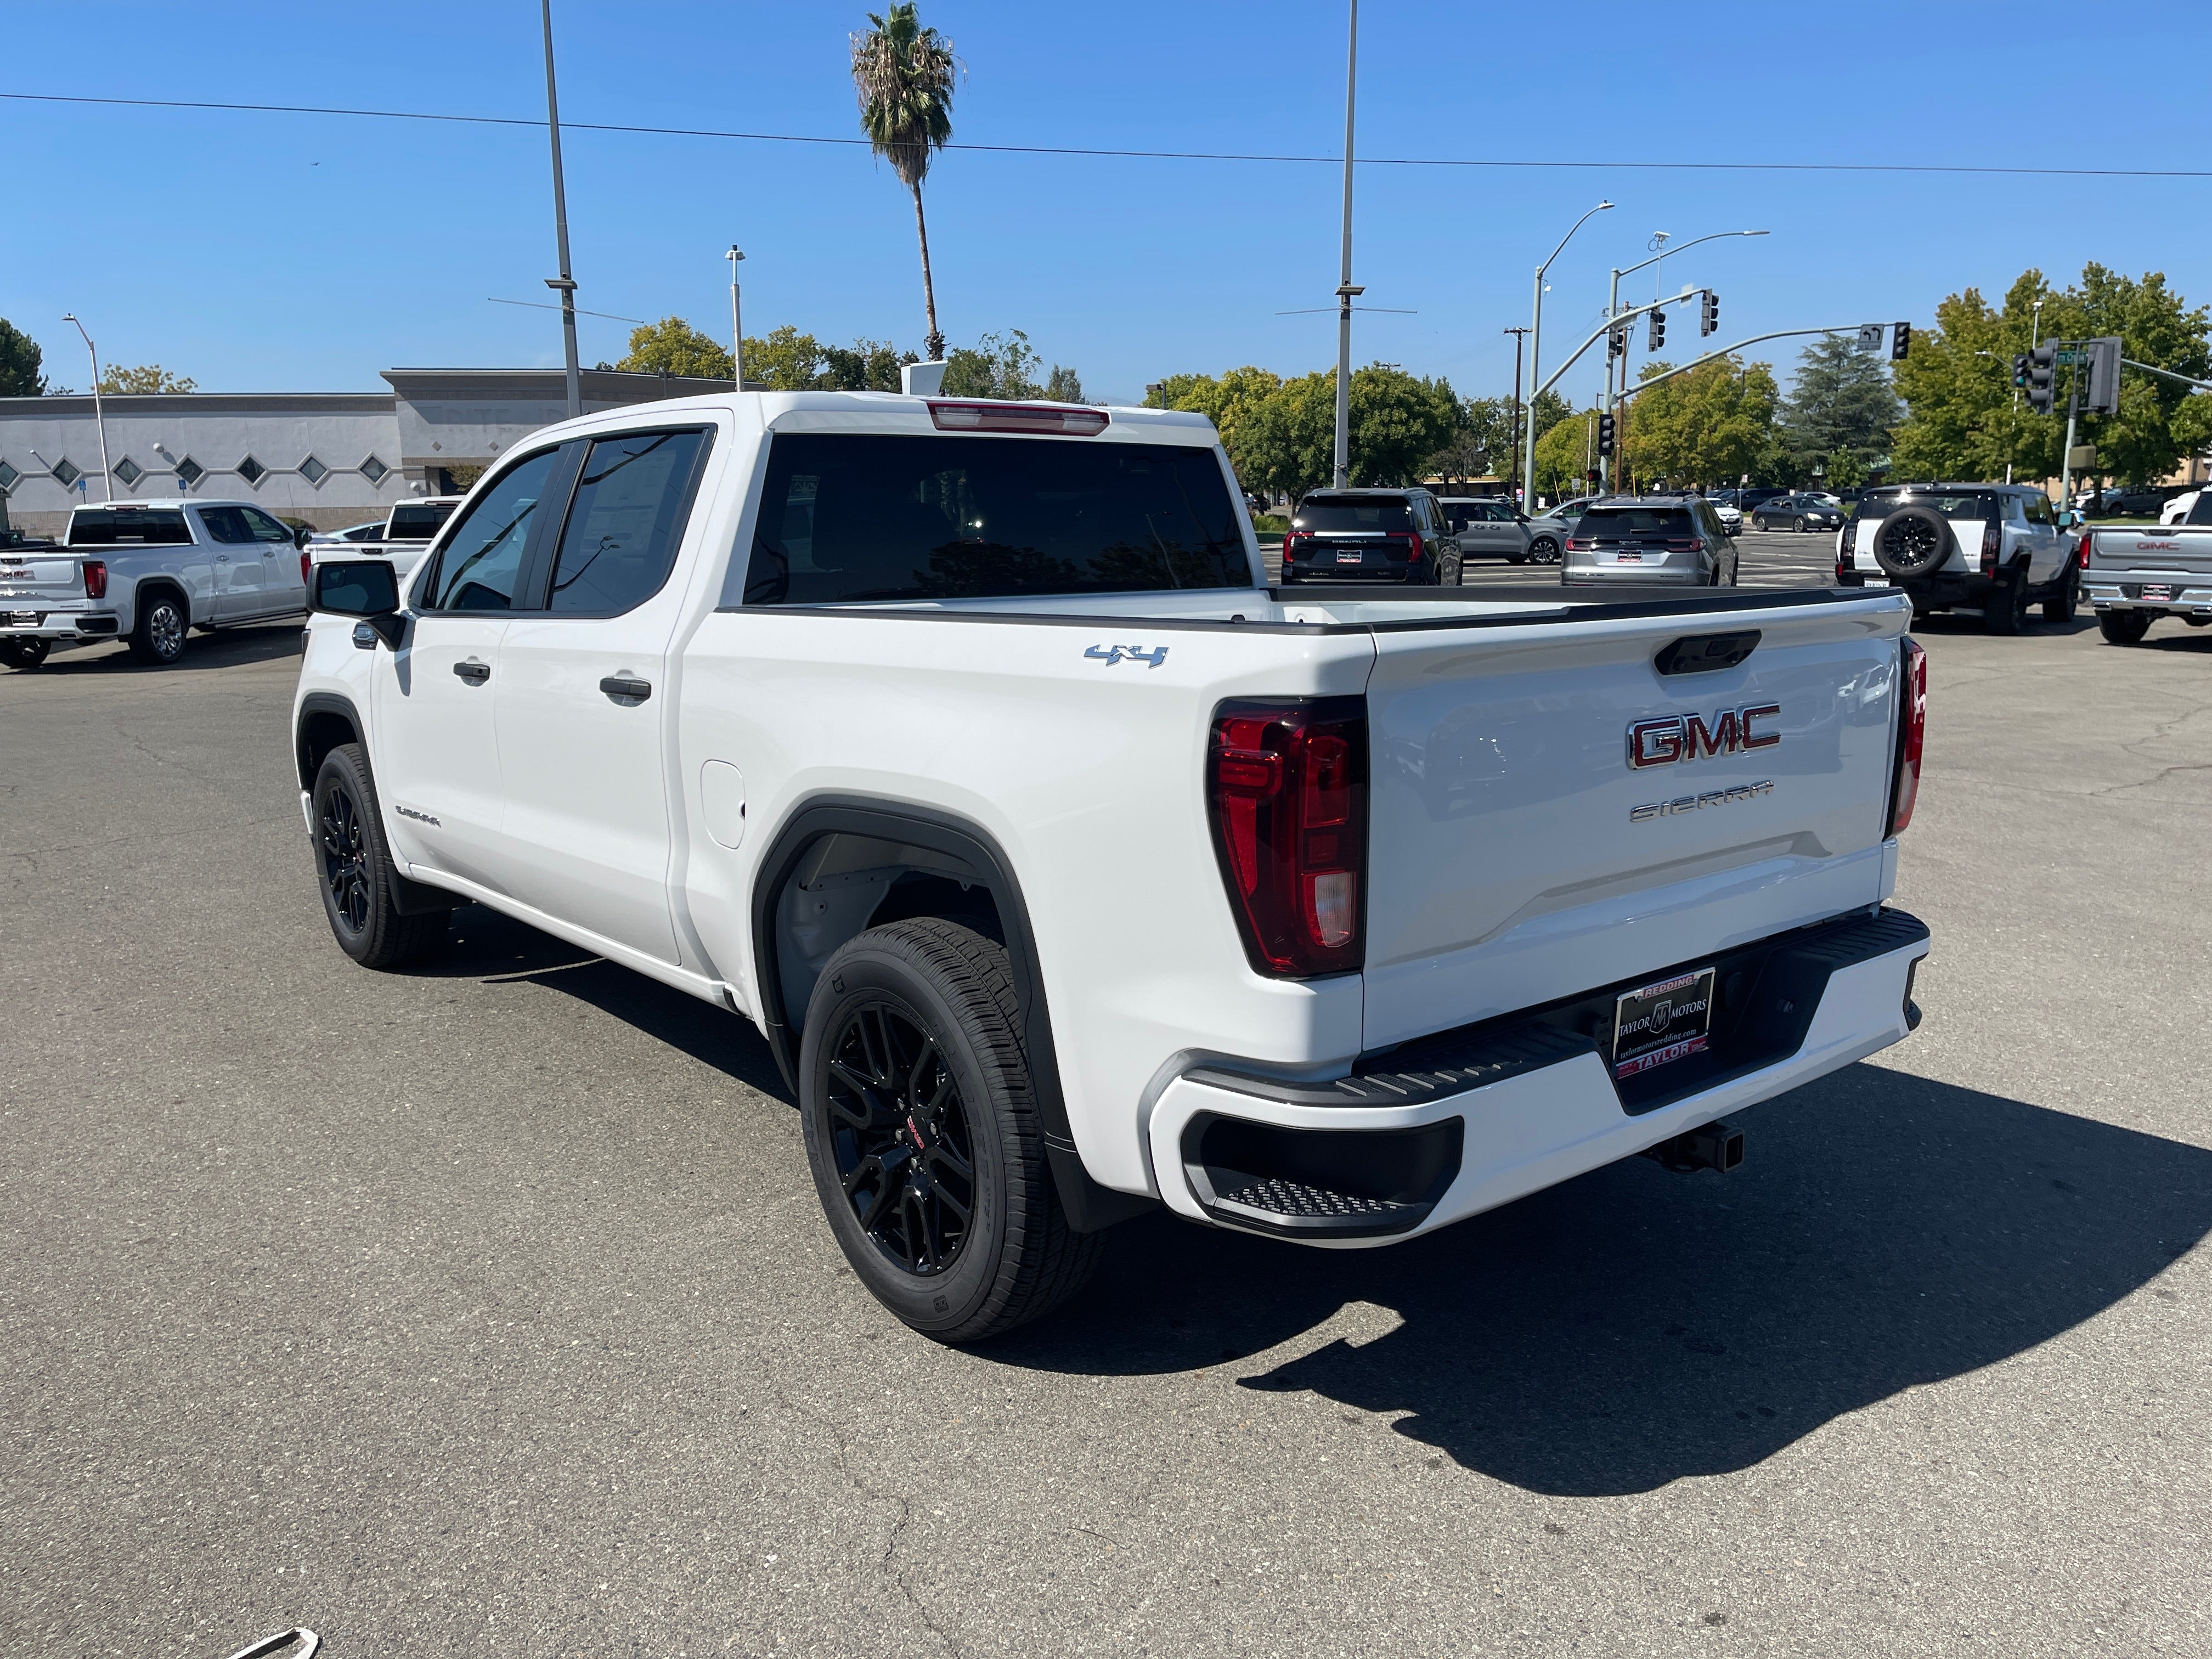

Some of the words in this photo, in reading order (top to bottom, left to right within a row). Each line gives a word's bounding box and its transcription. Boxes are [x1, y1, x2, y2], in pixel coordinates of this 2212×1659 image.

[2137, 541, 2181, 550] GMC
[1626, 701, 1781, 770] GMC
[1629, 780, 1774, 823] SIERRA
[1646, 977, 1693, 997] REDDING
[1620, 1017, 1650, 1037] TAYLOR
[1670, 999, 1707, 1019] MOTORS
[1620, 1029, 1696, 1059] taylormotorsredding.com
[1637, 1043, 1689, 1070] TAYLOR
[907, 1115, 925, 1149] GMC
